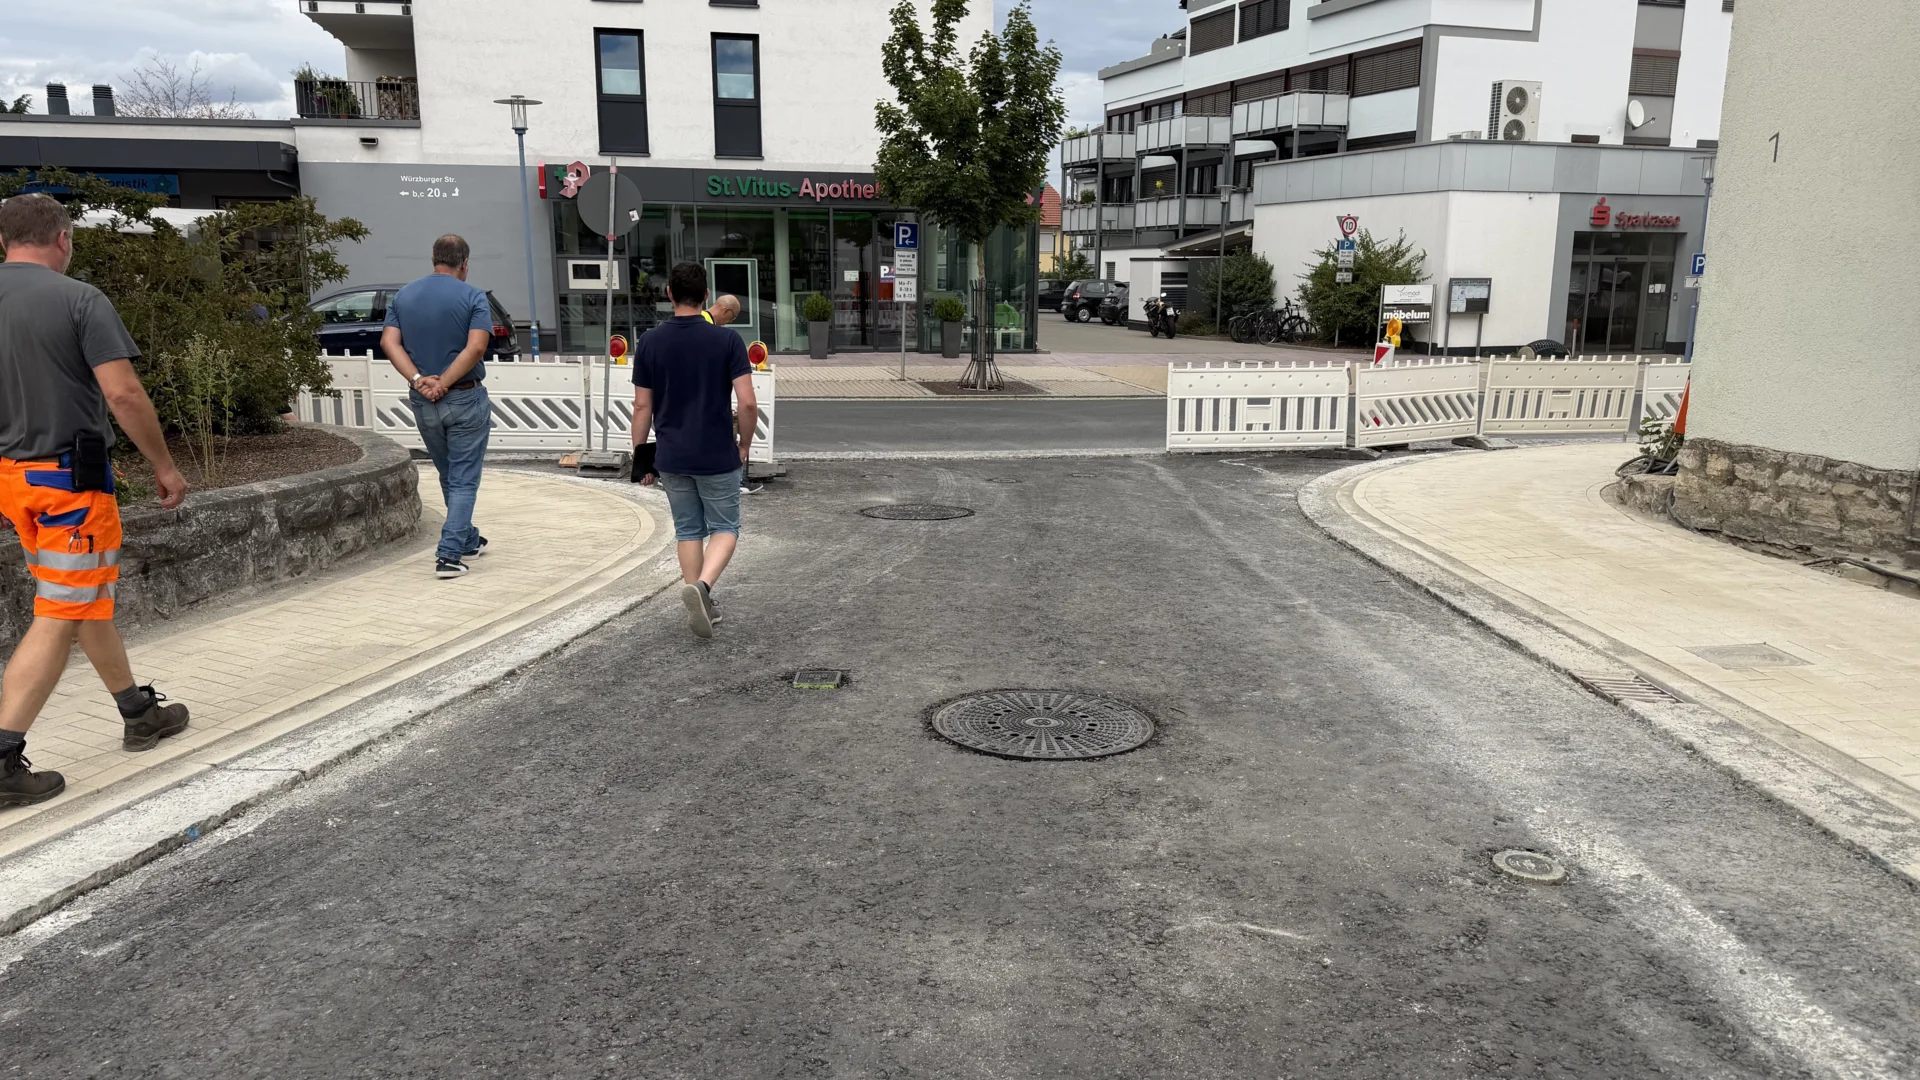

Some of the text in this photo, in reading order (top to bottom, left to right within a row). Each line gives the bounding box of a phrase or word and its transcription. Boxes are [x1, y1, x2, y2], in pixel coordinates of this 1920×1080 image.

[1769, 131, 1780, 163] 1
[400, 175, 443, 184] Würzburger
[412, 190, 425, 198] b,c
[427, 187, 441, 198] 20
[1616, 211, 1680, 229] Sparkasse
[1345, 221, 1354, 231] 10
[899, 226, 912, 245] P
[1344, 241, 1351, 250] P
[1696, 256, 1705, 273] P
[1383, 310, 1430, 319] möbelum
